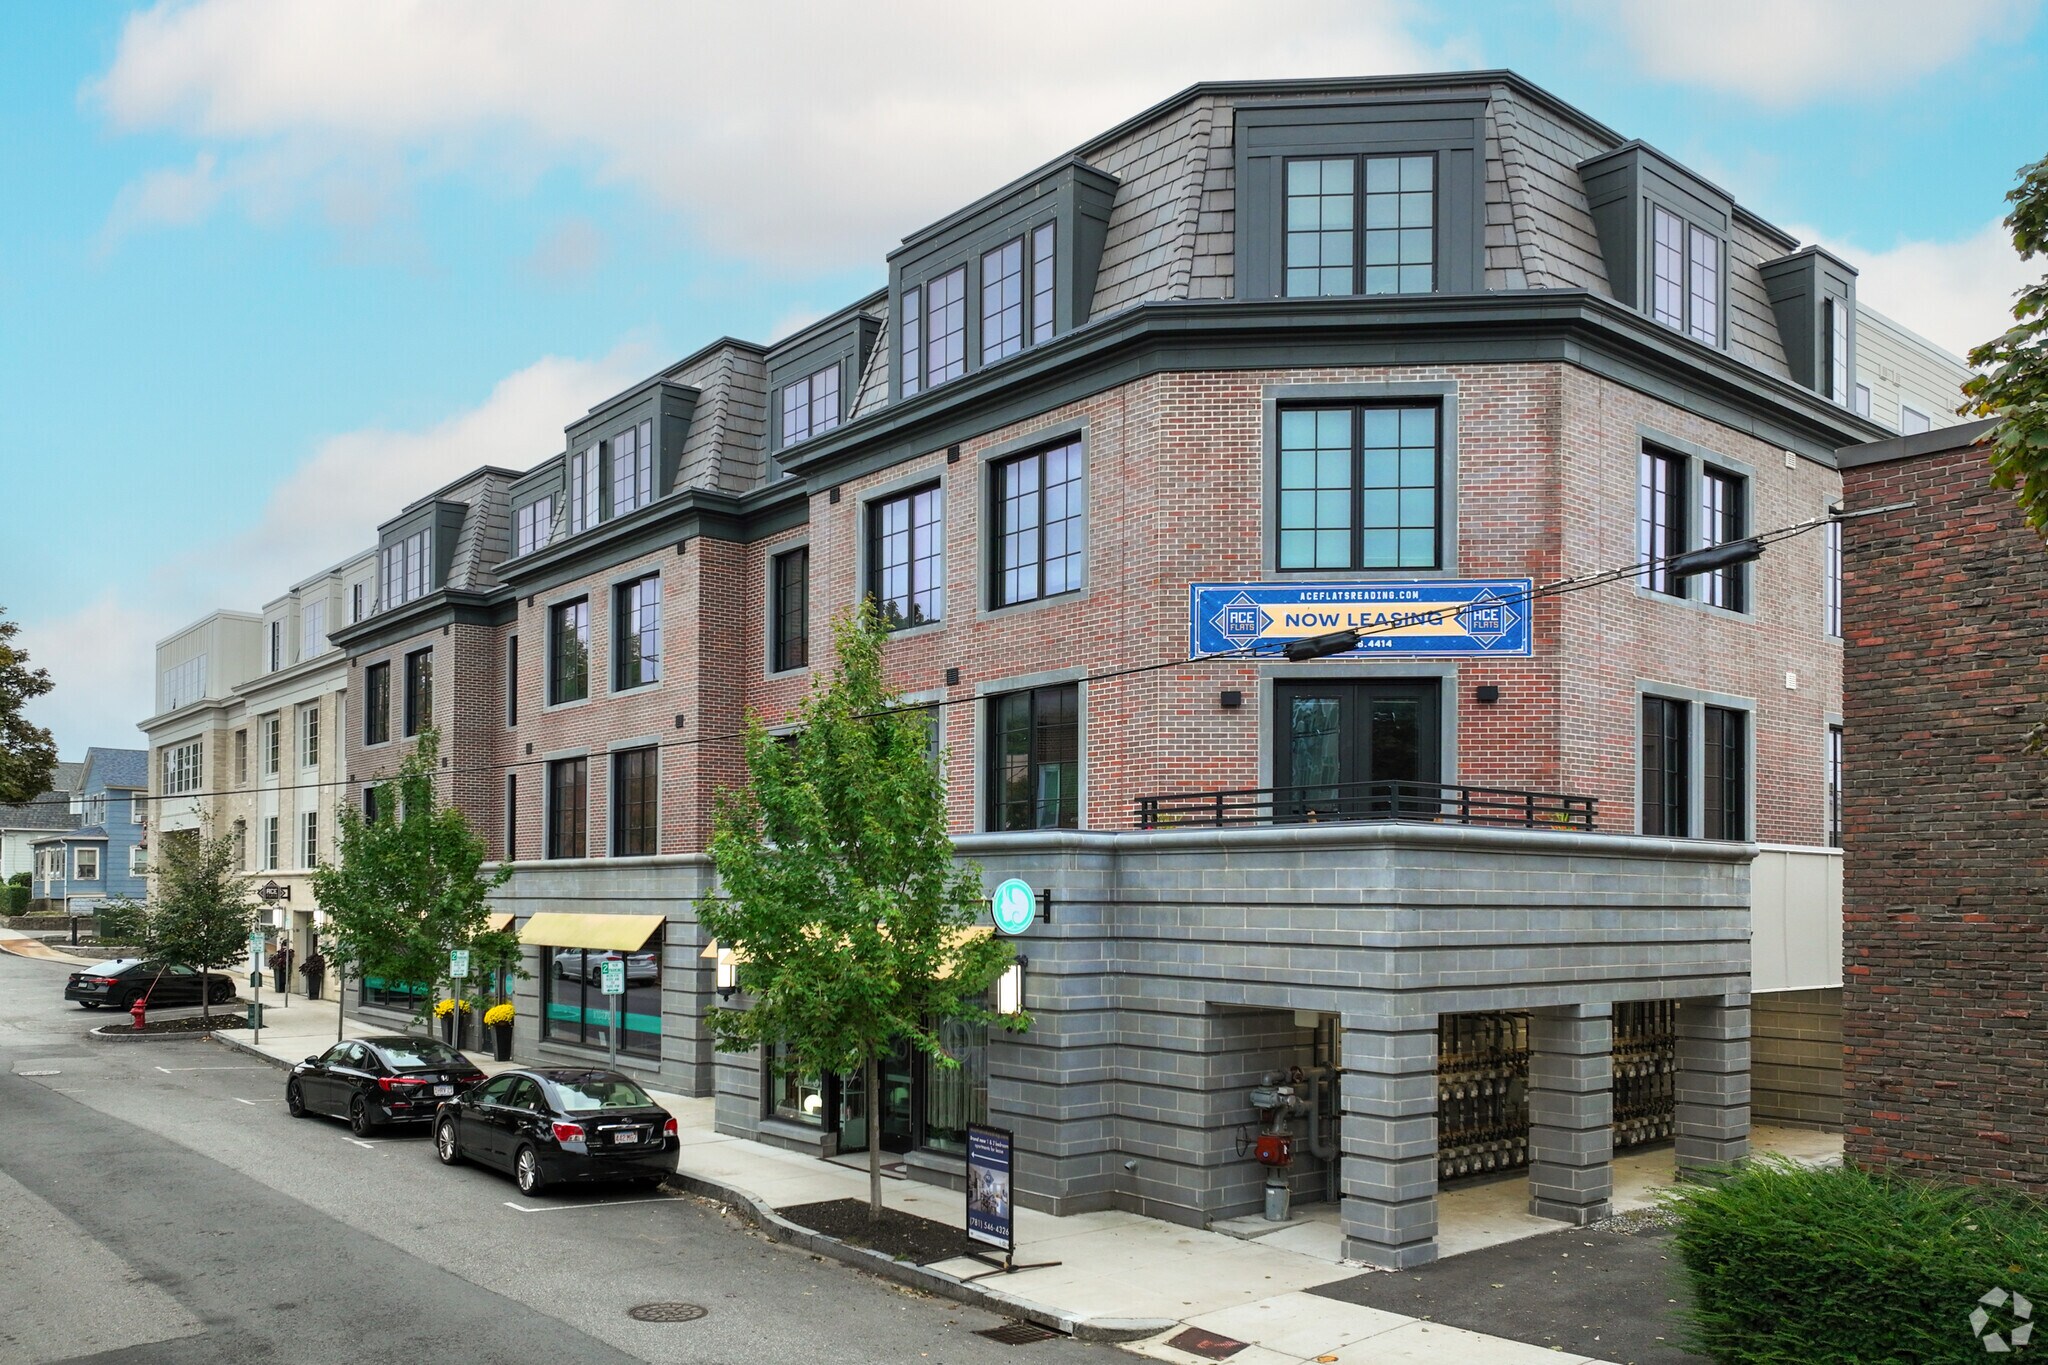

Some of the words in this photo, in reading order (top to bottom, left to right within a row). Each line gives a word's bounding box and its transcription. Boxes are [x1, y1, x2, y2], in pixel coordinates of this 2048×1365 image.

[1300, 591, 1419, 601] ACEFLATSREADING.COM
[1230, 611, 1255, 624] ACE
[1285, 613, 1340, 627] NOW
[1347, 612, 1443, 627] LEASING
[1473, 609, 1499, 621] ACE
[1230, 623, 1255, 631] FLATS
[1473, 620, 1499, 629] FLATS
[602, 964, 608, 973] 2
[970, 1217, 983, 1229] (781)
[984, 1221, 1010, 1236] 546-4326
